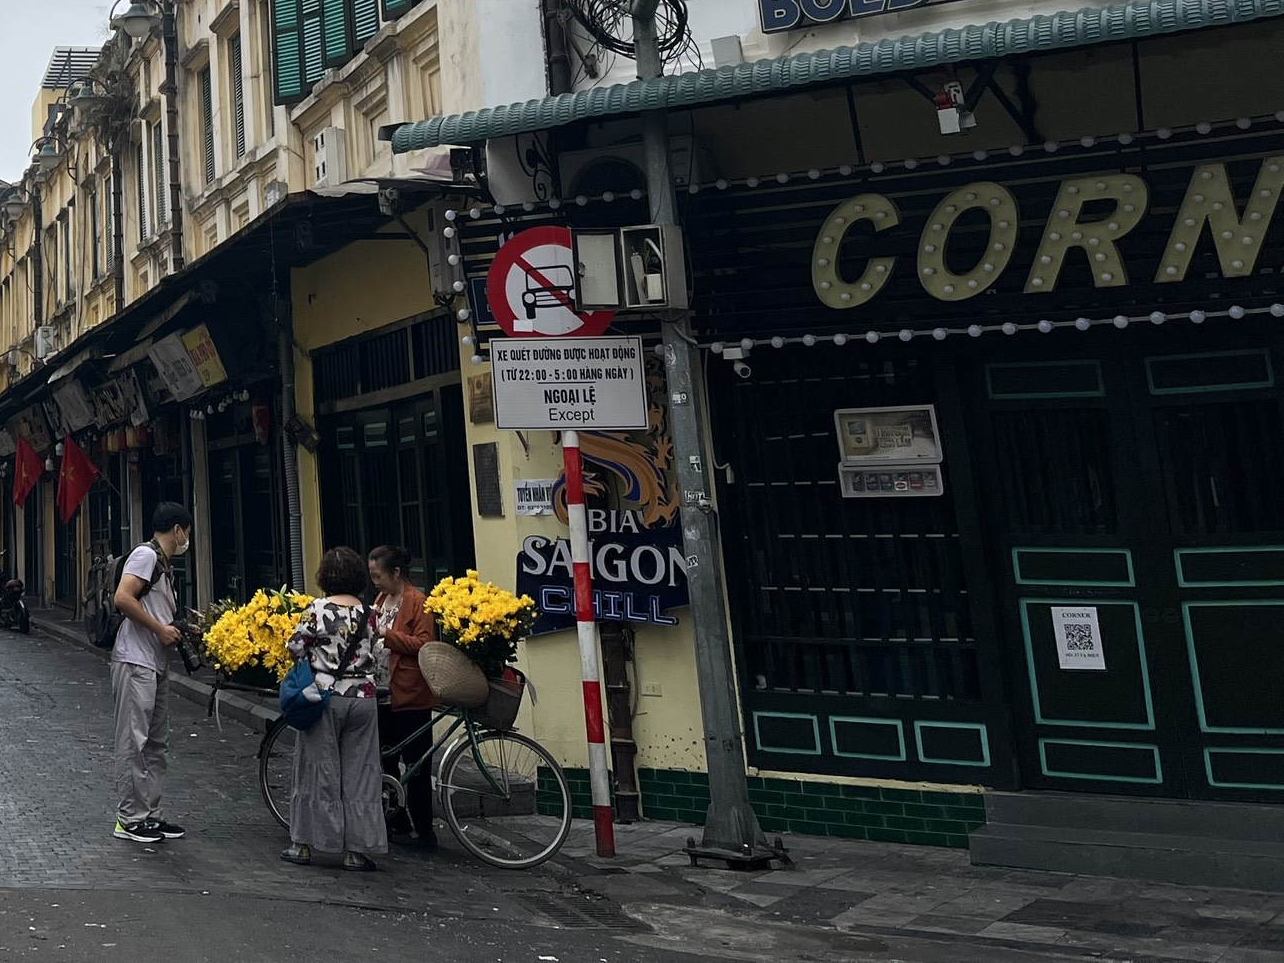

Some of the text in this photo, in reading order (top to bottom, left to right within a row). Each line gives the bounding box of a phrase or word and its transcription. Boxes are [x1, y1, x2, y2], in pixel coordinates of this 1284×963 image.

[497, 345, 636, 362] XE QUÉT ĐƯỜNG ĐƯỢC HOẠT ĐỘNG
[579, 365, 603, 380] HÀNG
[605, 365, 628, 380] NGÀY
[543, 385, 597, 406] NGOẠI LỆ
[548, 407, 595, 424] Except
[588, 508, 640, 534] BIA
[540, 585, 679, 626] CHILL
